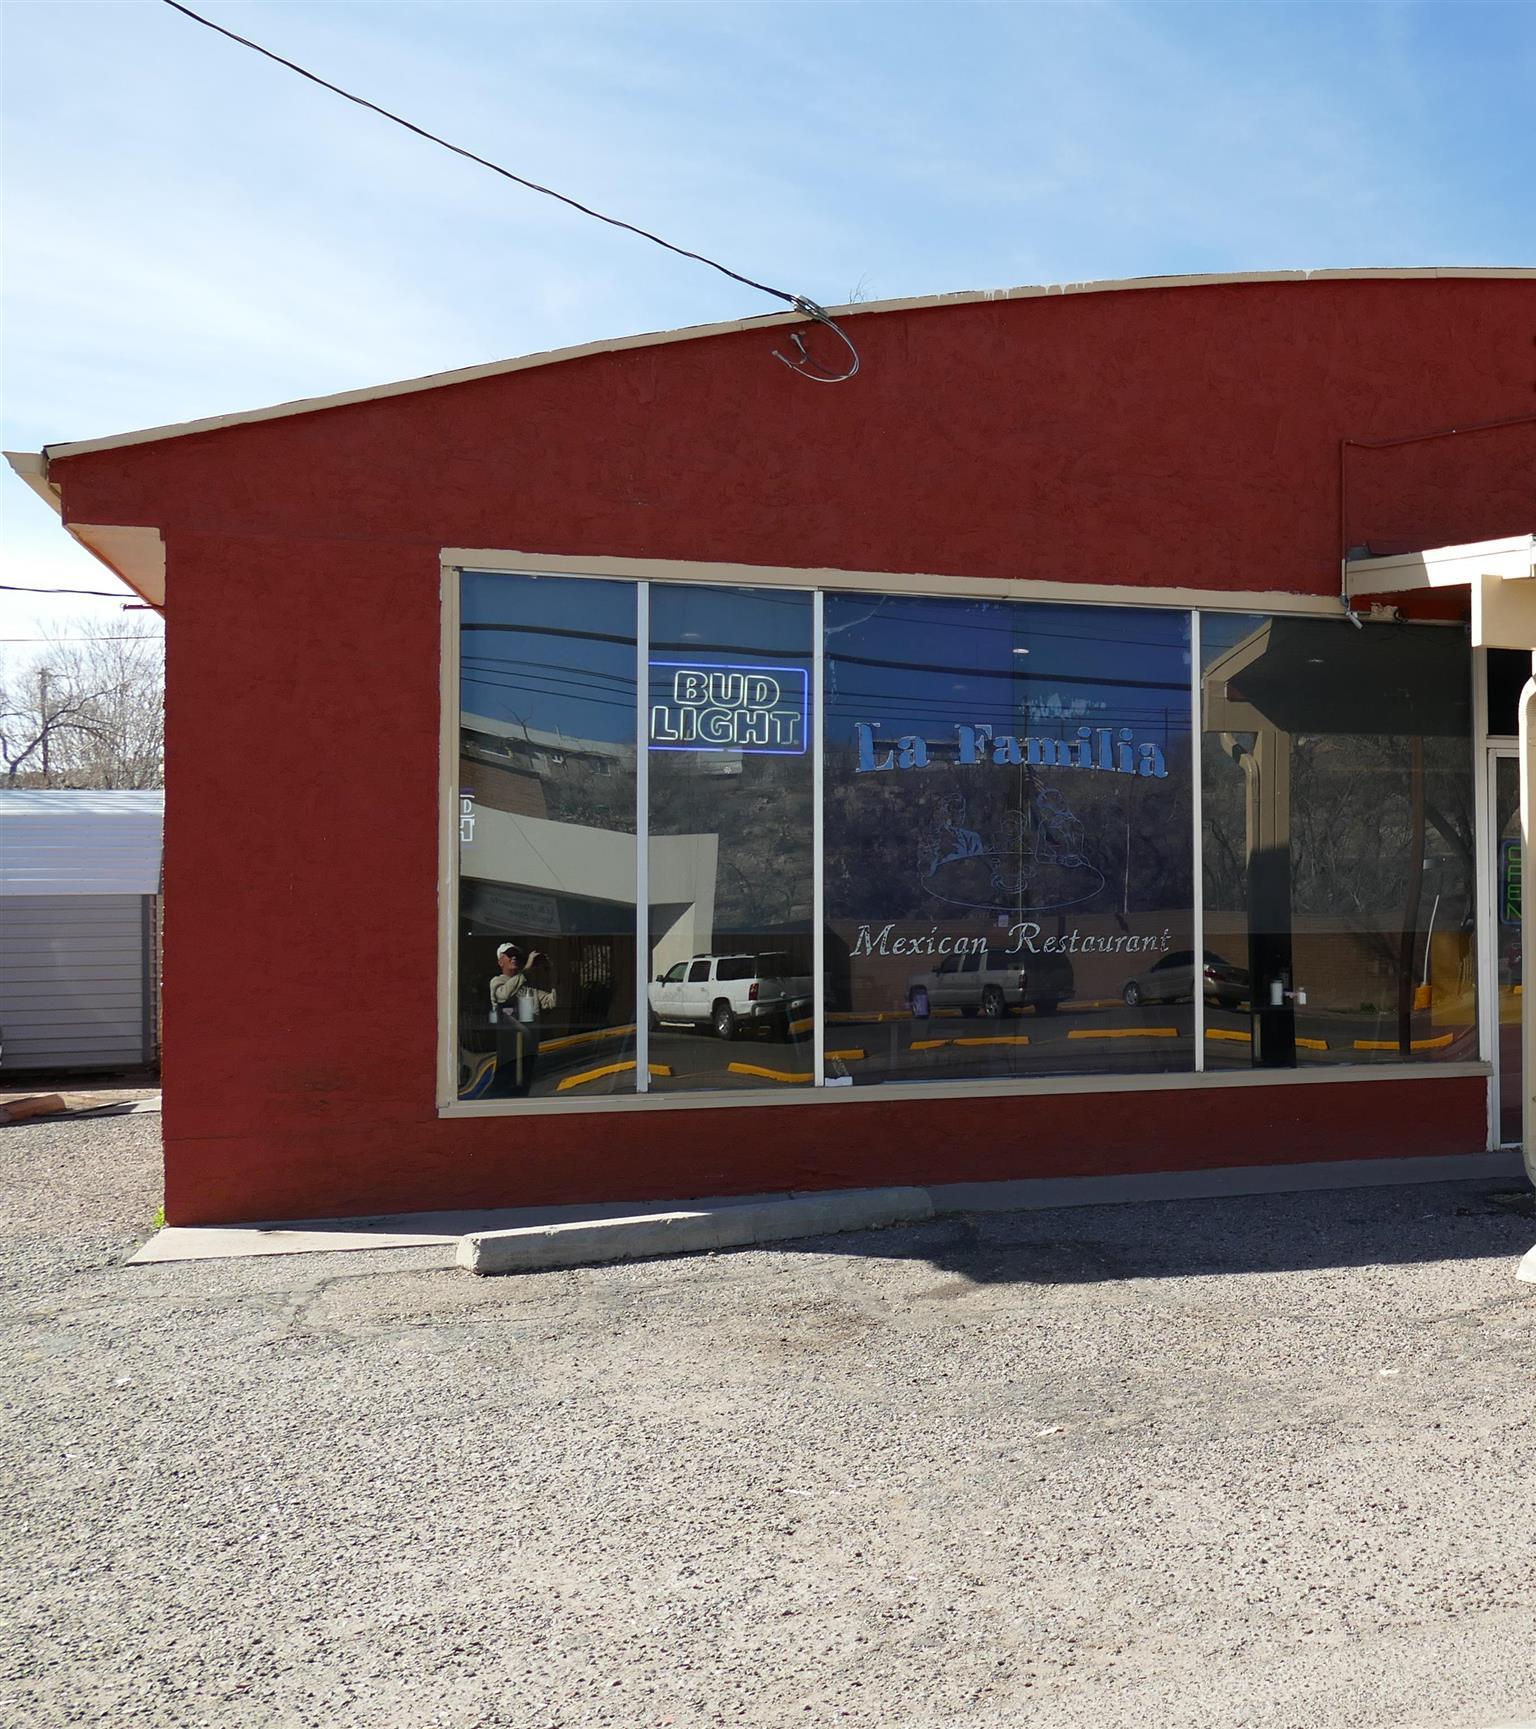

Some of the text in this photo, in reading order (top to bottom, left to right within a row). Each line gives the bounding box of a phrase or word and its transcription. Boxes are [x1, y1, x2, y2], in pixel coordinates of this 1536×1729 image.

[674, 670, 780, 709] BUD
[651, 705, 800, 745] LIGHT
[854, 722, 1169, 779] La Familia
[850, 922, 1172, 957] Mexican Restaurant
